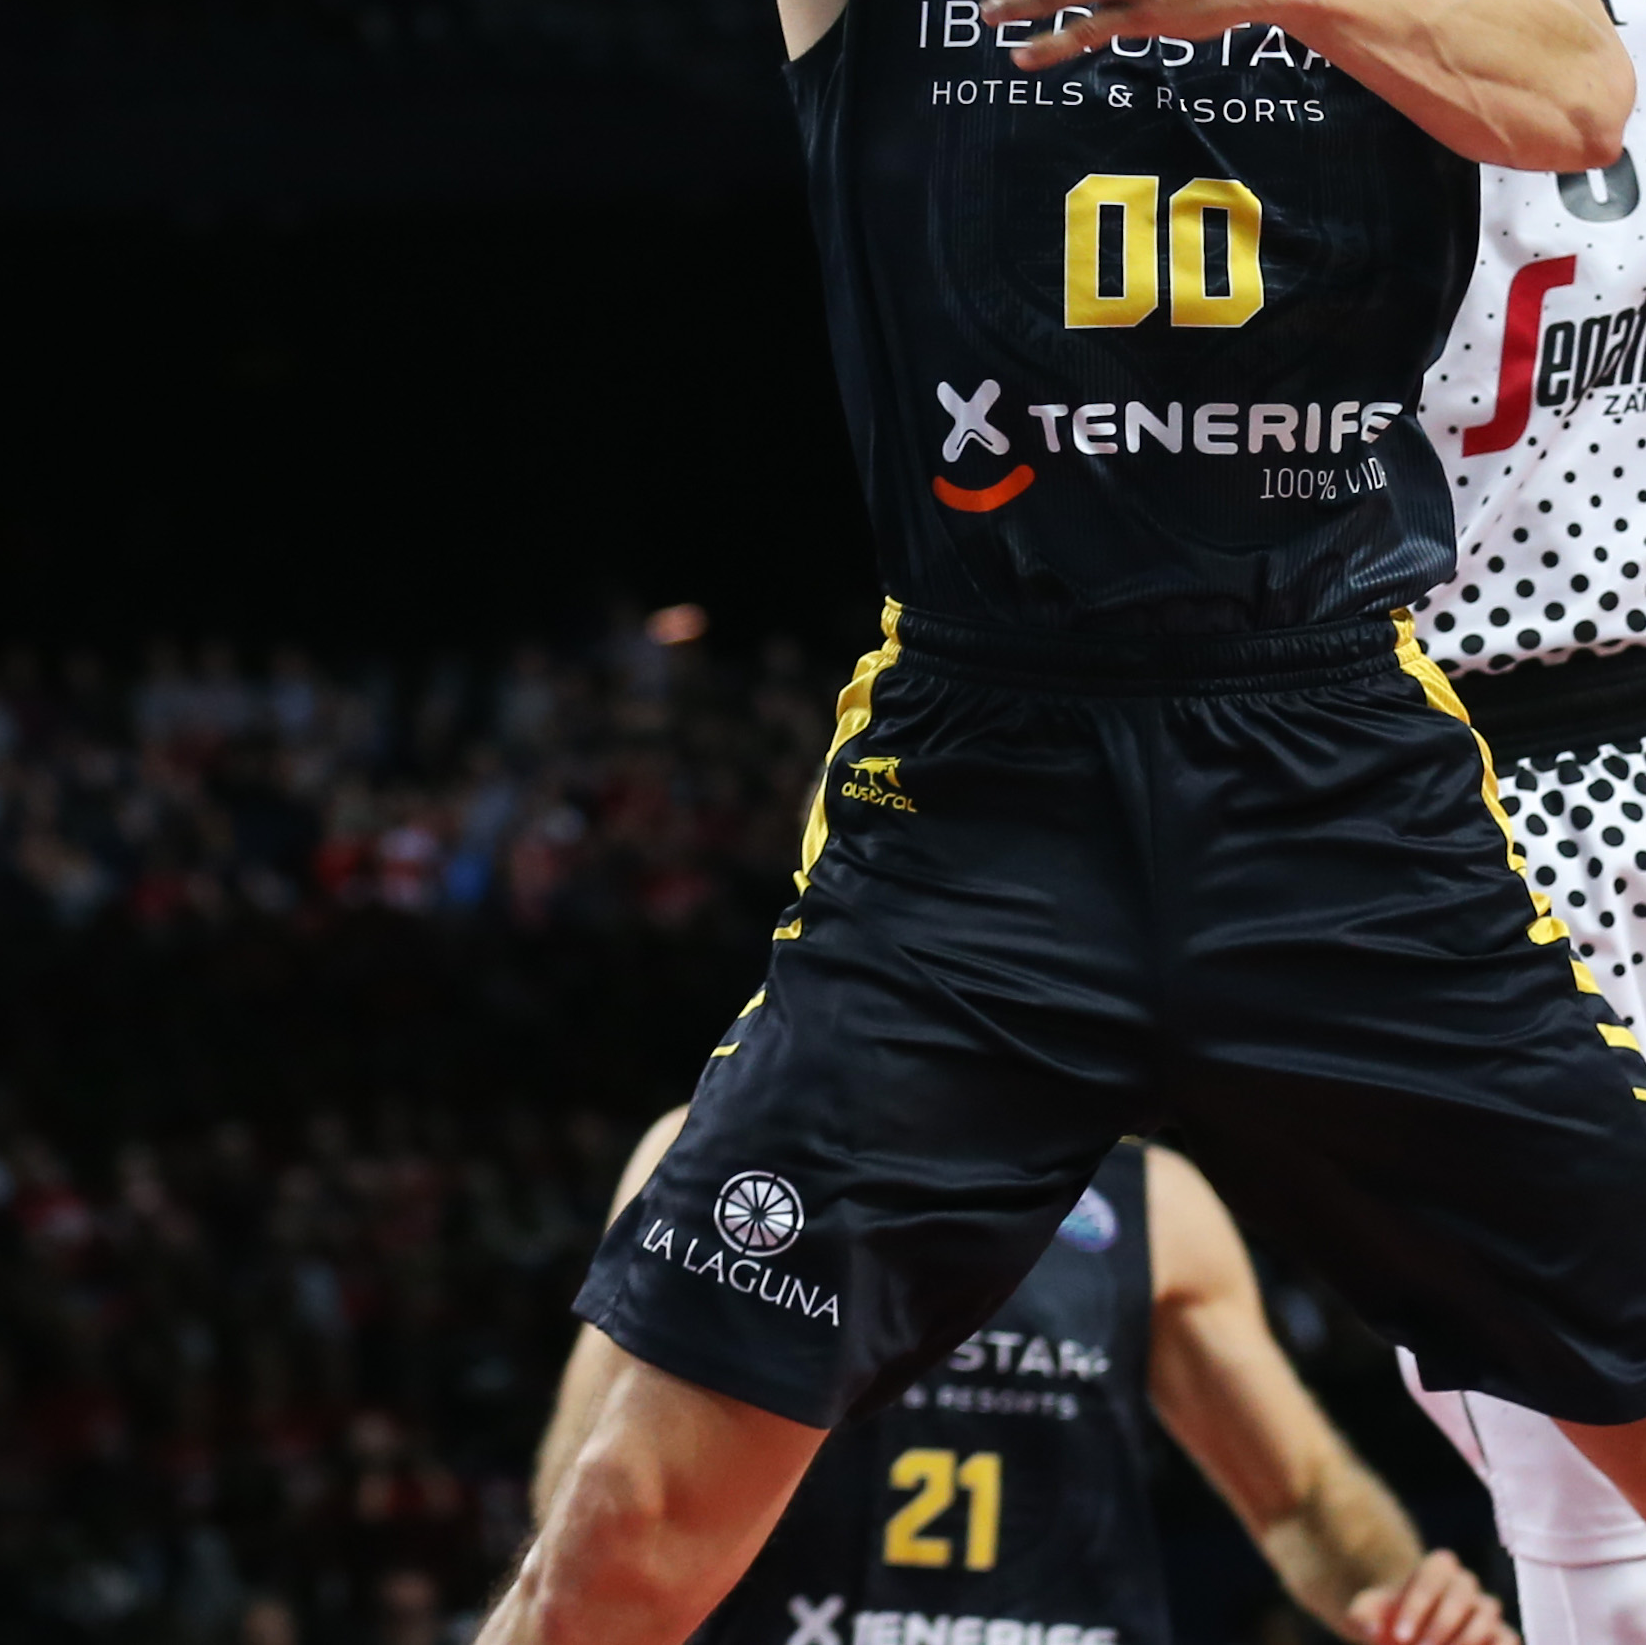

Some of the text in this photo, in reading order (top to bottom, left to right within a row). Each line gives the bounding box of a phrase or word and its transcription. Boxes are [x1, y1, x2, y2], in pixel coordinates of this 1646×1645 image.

[932, 80, 1326, 123] HOTELS & RSORTS
[1064, 173, 1264, 330] 00
[1028, 401, 1403, 455] TENERIFE
[1260, 467, 1337, 500] 100%
[841, 782, 918, 813] austral
[642, 1218, 840, 1327] LA LAGUNA
[882, 1447, 1003, 1573] 21
